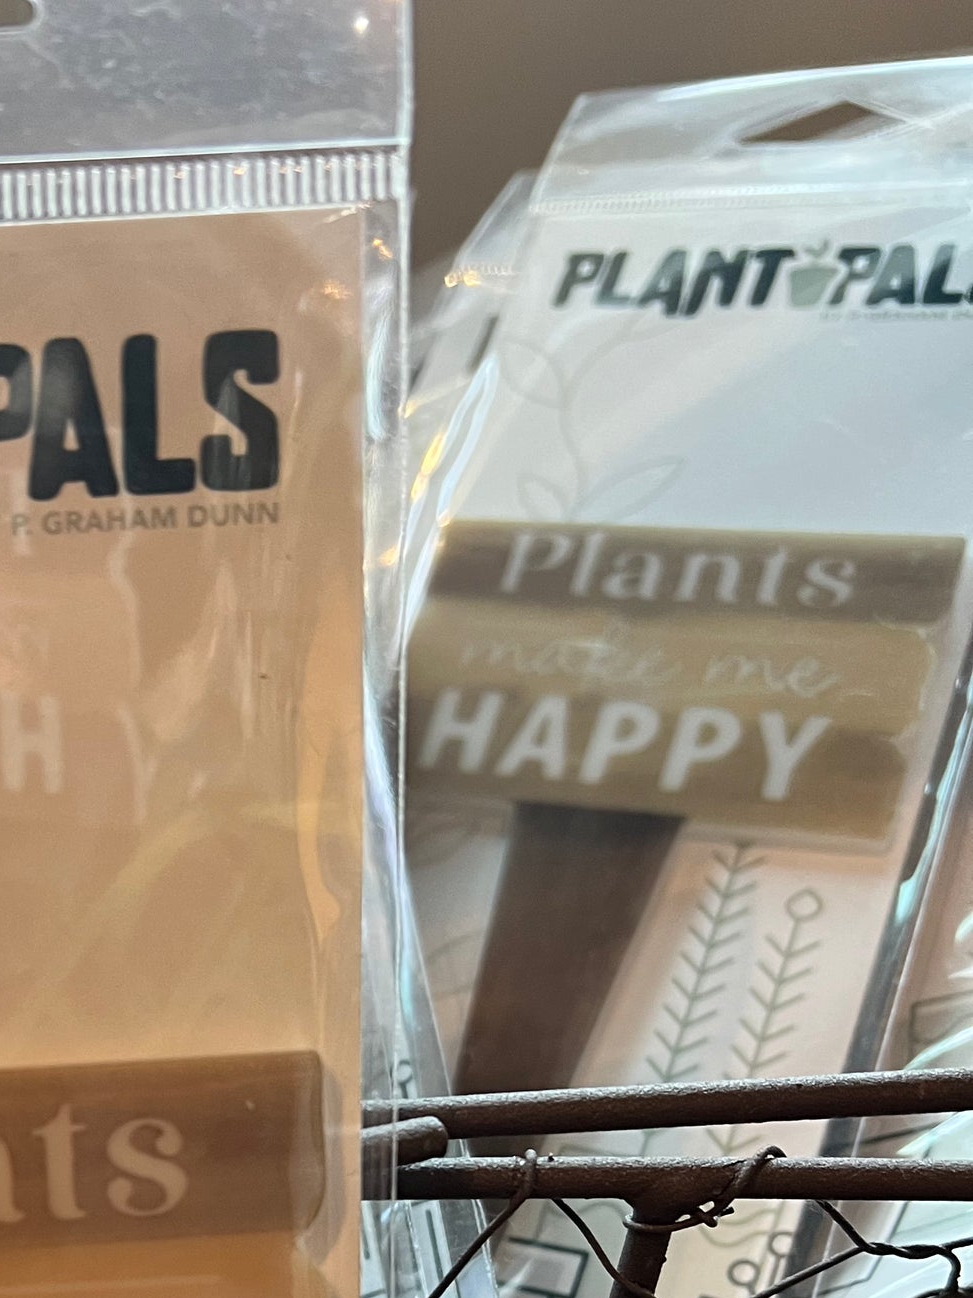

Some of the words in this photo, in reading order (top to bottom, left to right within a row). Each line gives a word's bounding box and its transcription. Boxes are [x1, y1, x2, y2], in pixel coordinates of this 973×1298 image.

[552, 247, 795, 319] PLANT
[829, 243, 973, 306] PAL
[41, 504, 177, 535] GRAHAM
[186, 501, 279, 528] DUNN
[500, 528, 858, 607] Plants
[703, 652, 843, 699] me
[417, 685, 834, 801] HAPPY
